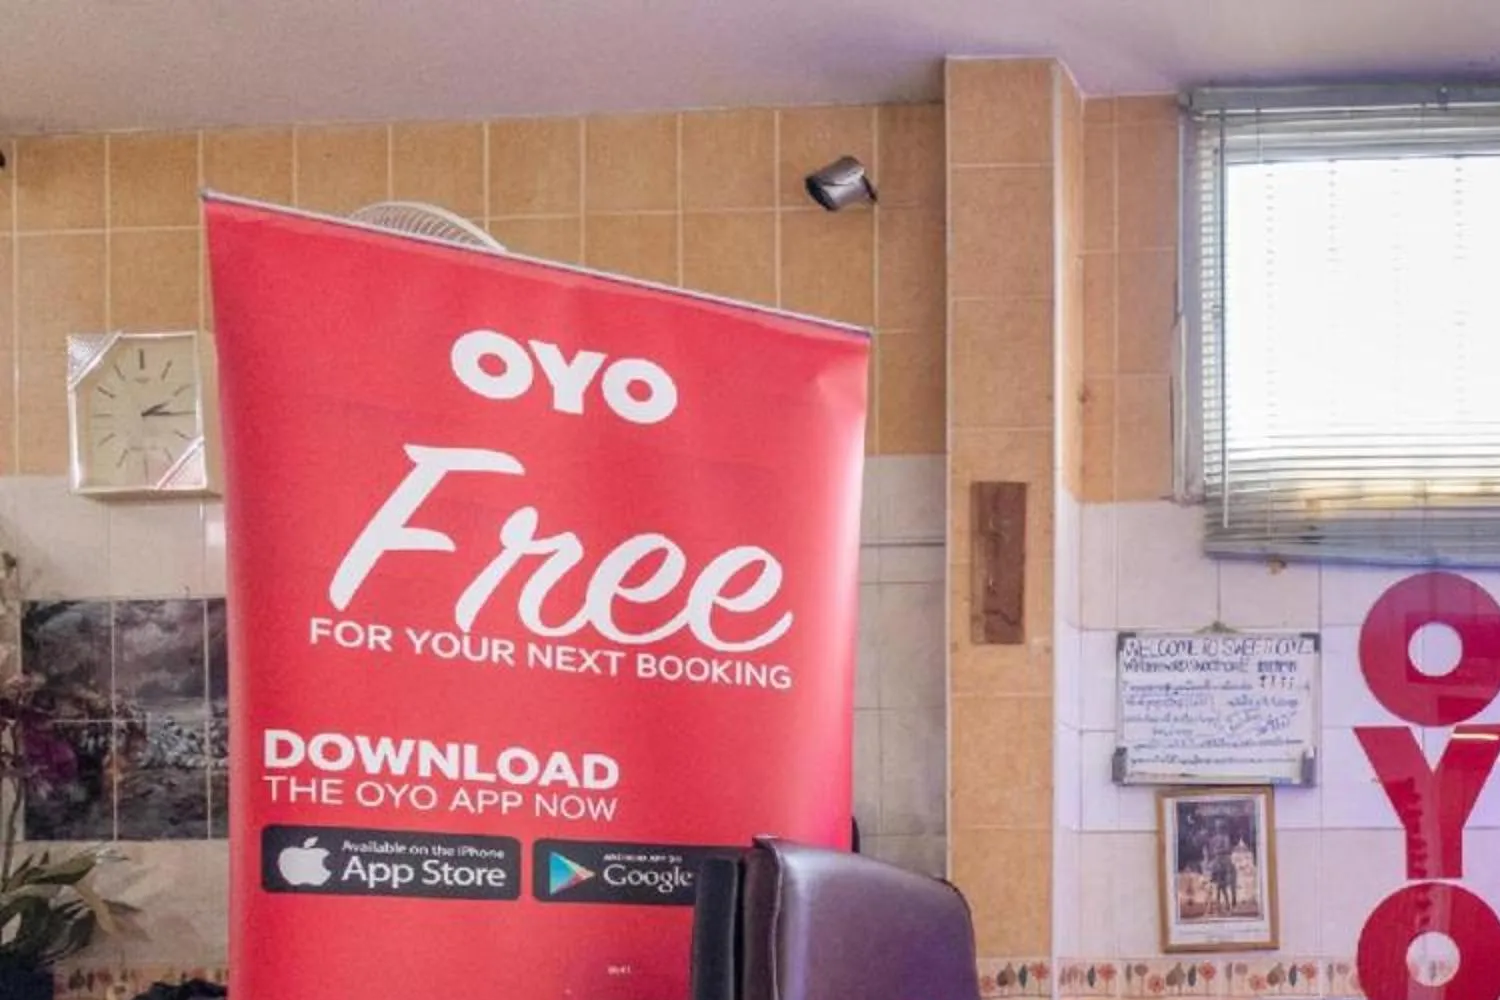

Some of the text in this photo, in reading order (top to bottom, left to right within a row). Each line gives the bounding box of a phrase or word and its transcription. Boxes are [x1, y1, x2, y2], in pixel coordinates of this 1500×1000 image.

[451, 330, 678, 424] OYO
[329, 443, 793, 651] Free
[310, 617, 793, 690] FOR YOUR NEXT BOOKING
[263, 728, 620, 790] DOWNLOAD
[263, 774, 619, 823] THE OYO APP NOW
[341, 839, 505, 860] Available on the iPhone
[341, 855, 507, 889] App Store
[603, 863, 694, 893] Google
